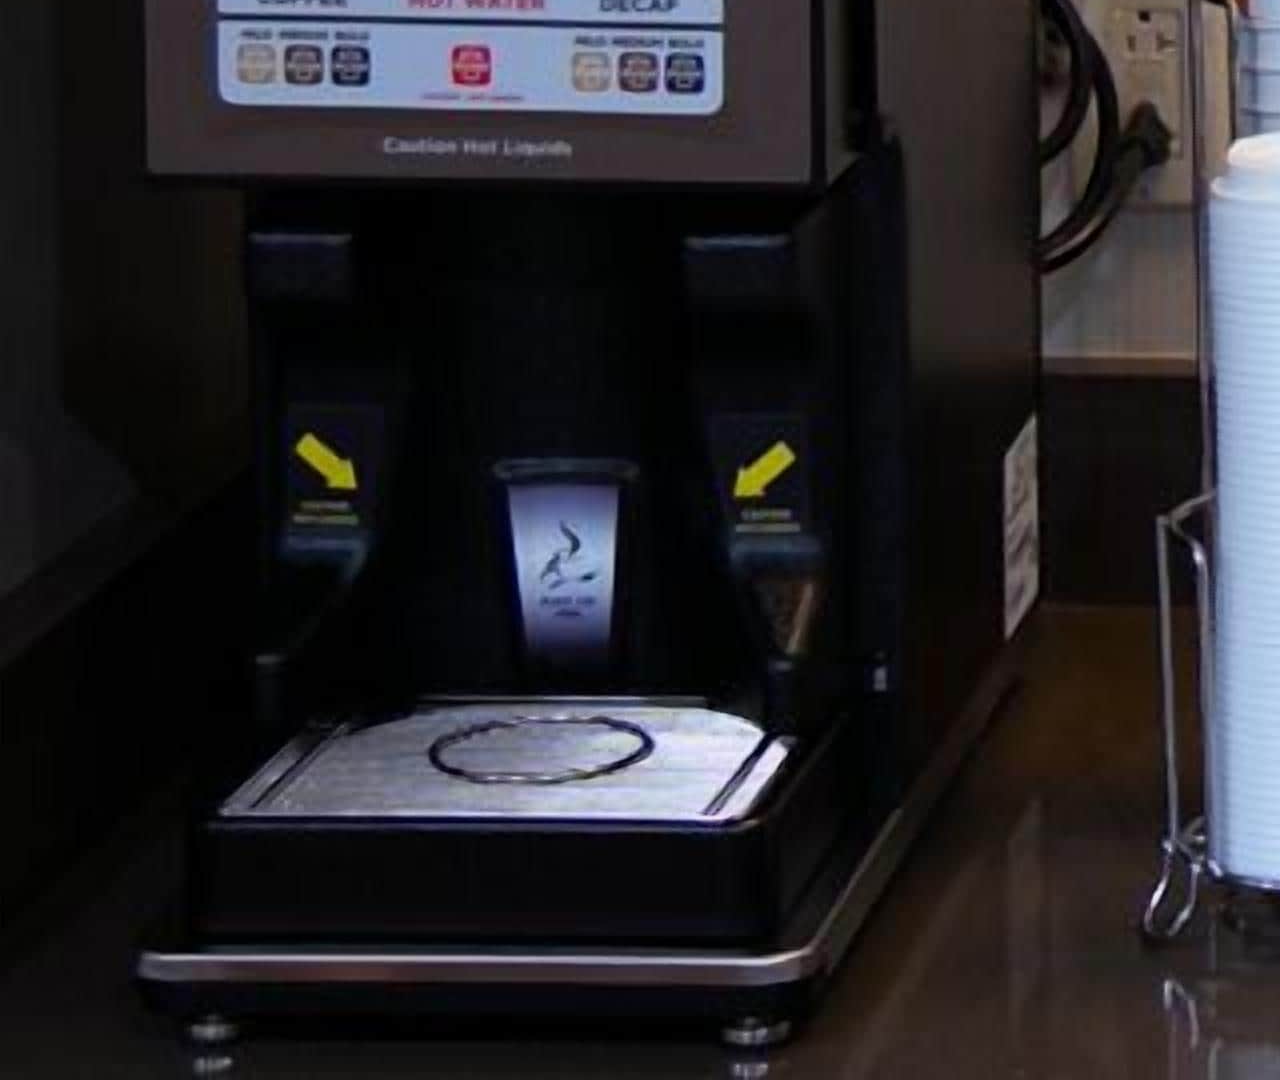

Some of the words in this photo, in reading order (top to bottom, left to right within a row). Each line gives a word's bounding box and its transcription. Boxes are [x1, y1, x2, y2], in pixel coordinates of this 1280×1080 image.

[383, 136, 456, 154] Caution
[463, 137, 497, 154] Hot
[504, 138, 573, 158] Liquids
